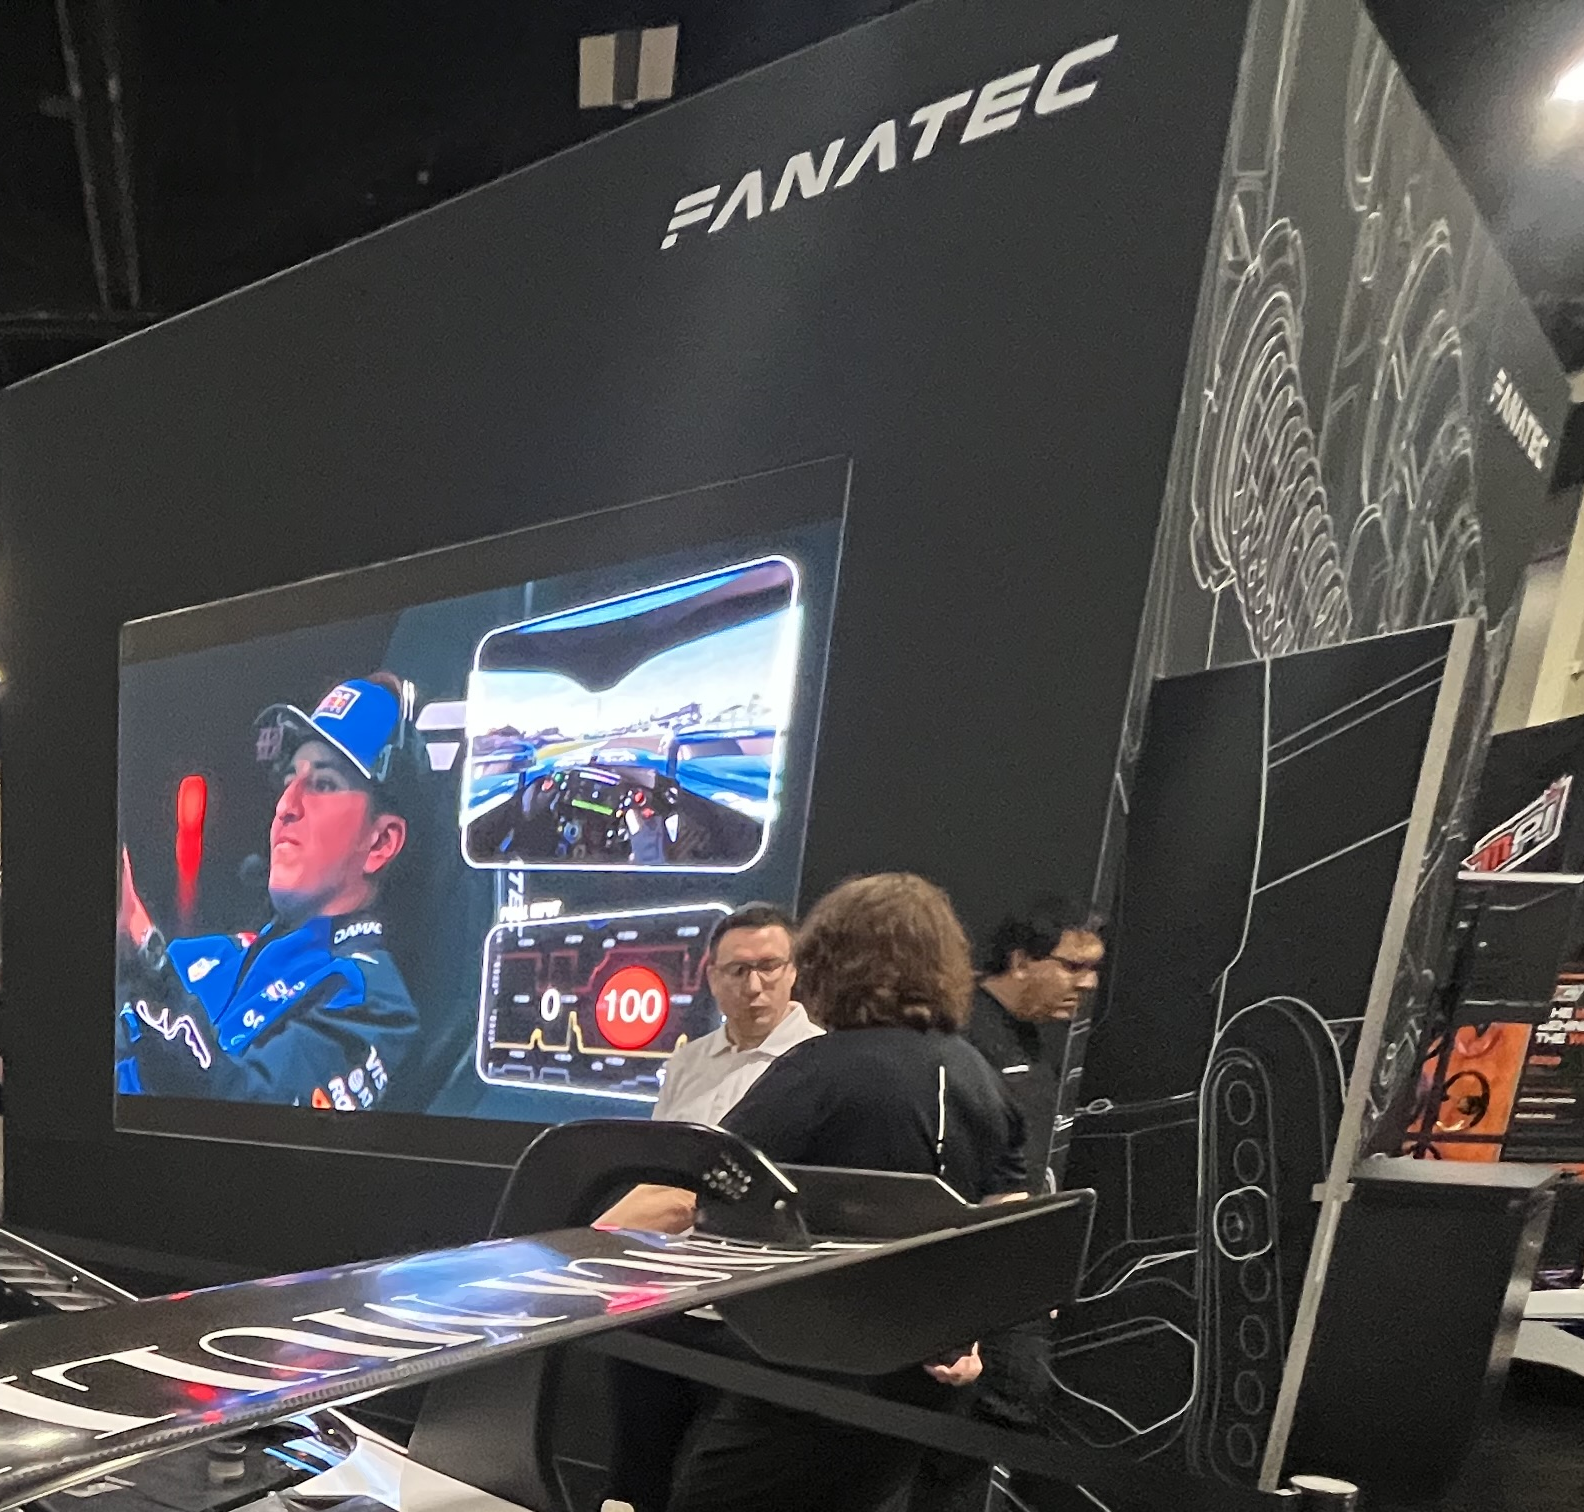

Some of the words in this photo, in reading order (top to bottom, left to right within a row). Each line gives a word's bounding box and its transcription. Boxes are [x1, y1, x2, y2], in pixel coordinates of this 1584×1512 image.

[660, 34, 1118, 250] FANATEC
[1487, 367, 1551, 470] FANATEC
[540, 988, 561, 1022] 0
[604, 988, 662, 1023] 100
